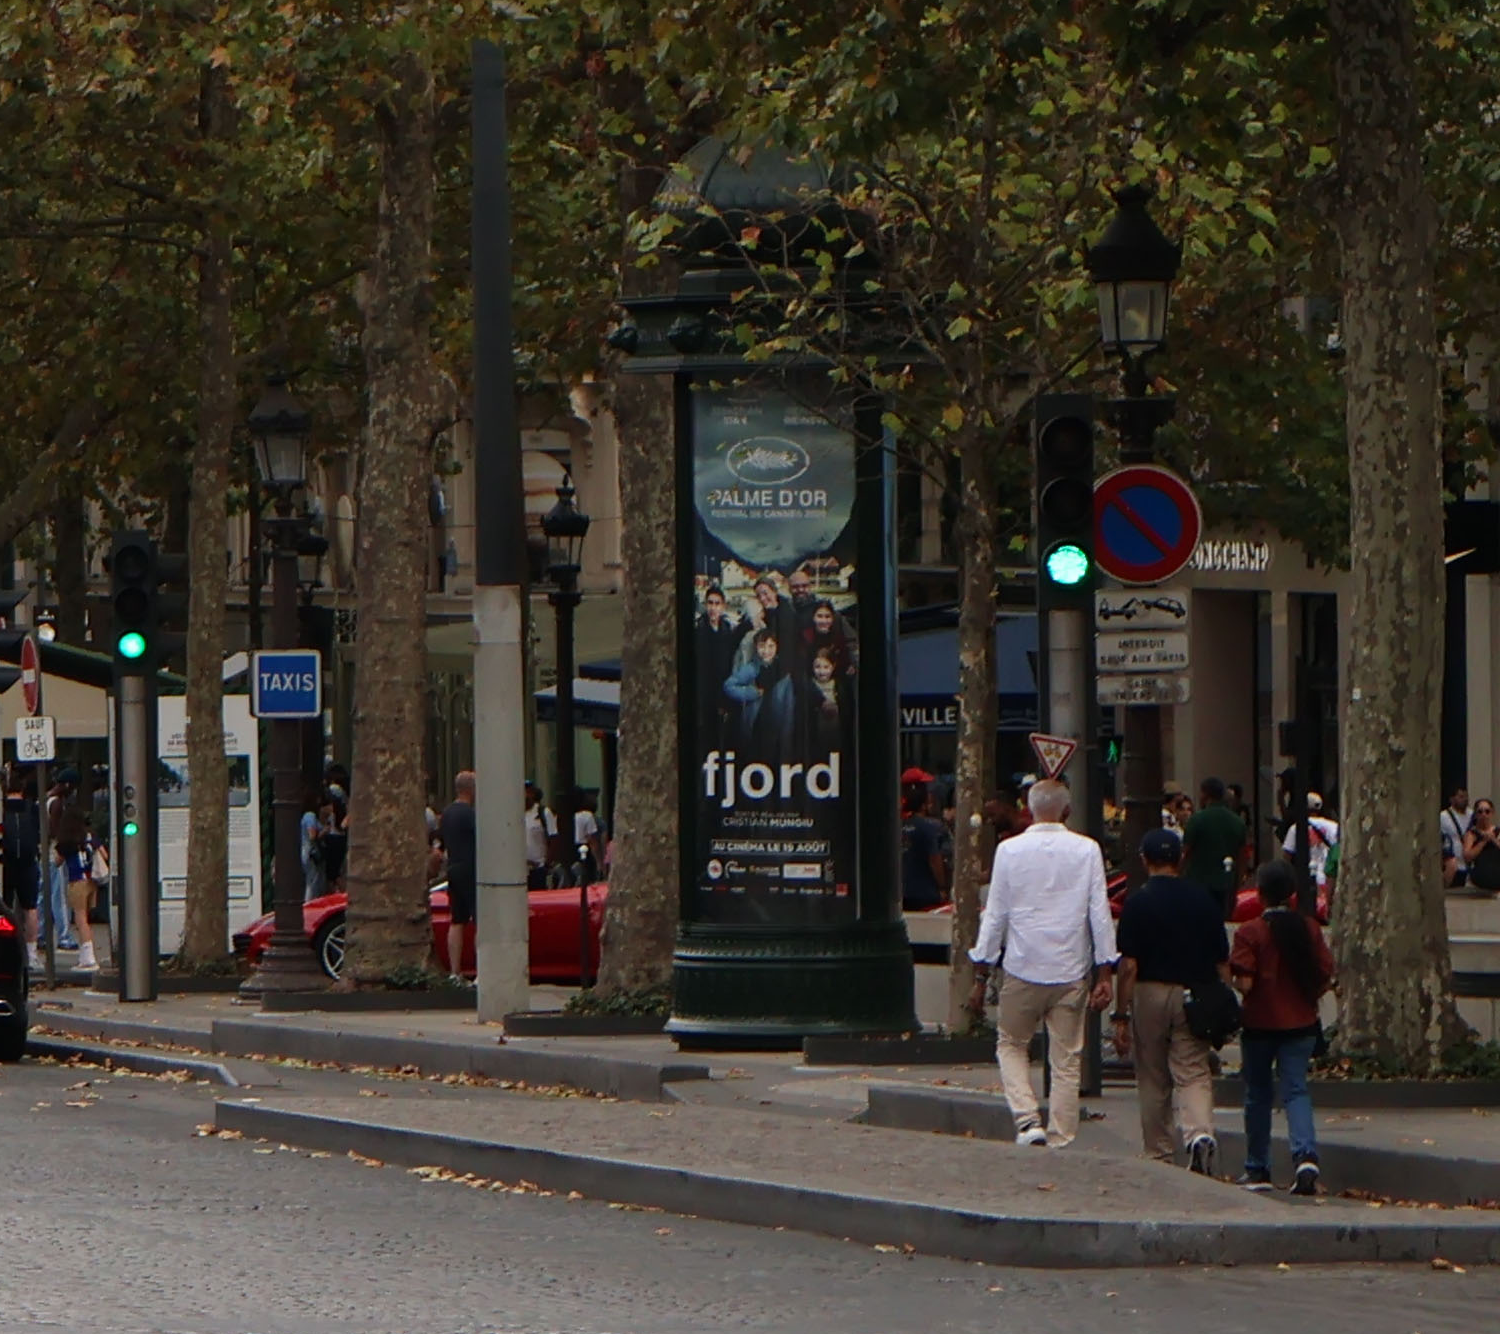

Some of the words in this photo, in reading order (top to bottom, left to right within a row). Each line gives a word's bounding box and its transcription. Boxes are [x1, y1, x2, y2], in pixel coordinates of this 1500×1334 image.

[779, 489, 827, 506] D'OR
[261, 673, 315, 692] TAXIS
[25, 719, 45, 729] SAUF
[703, 751, 841, 808] fjord
